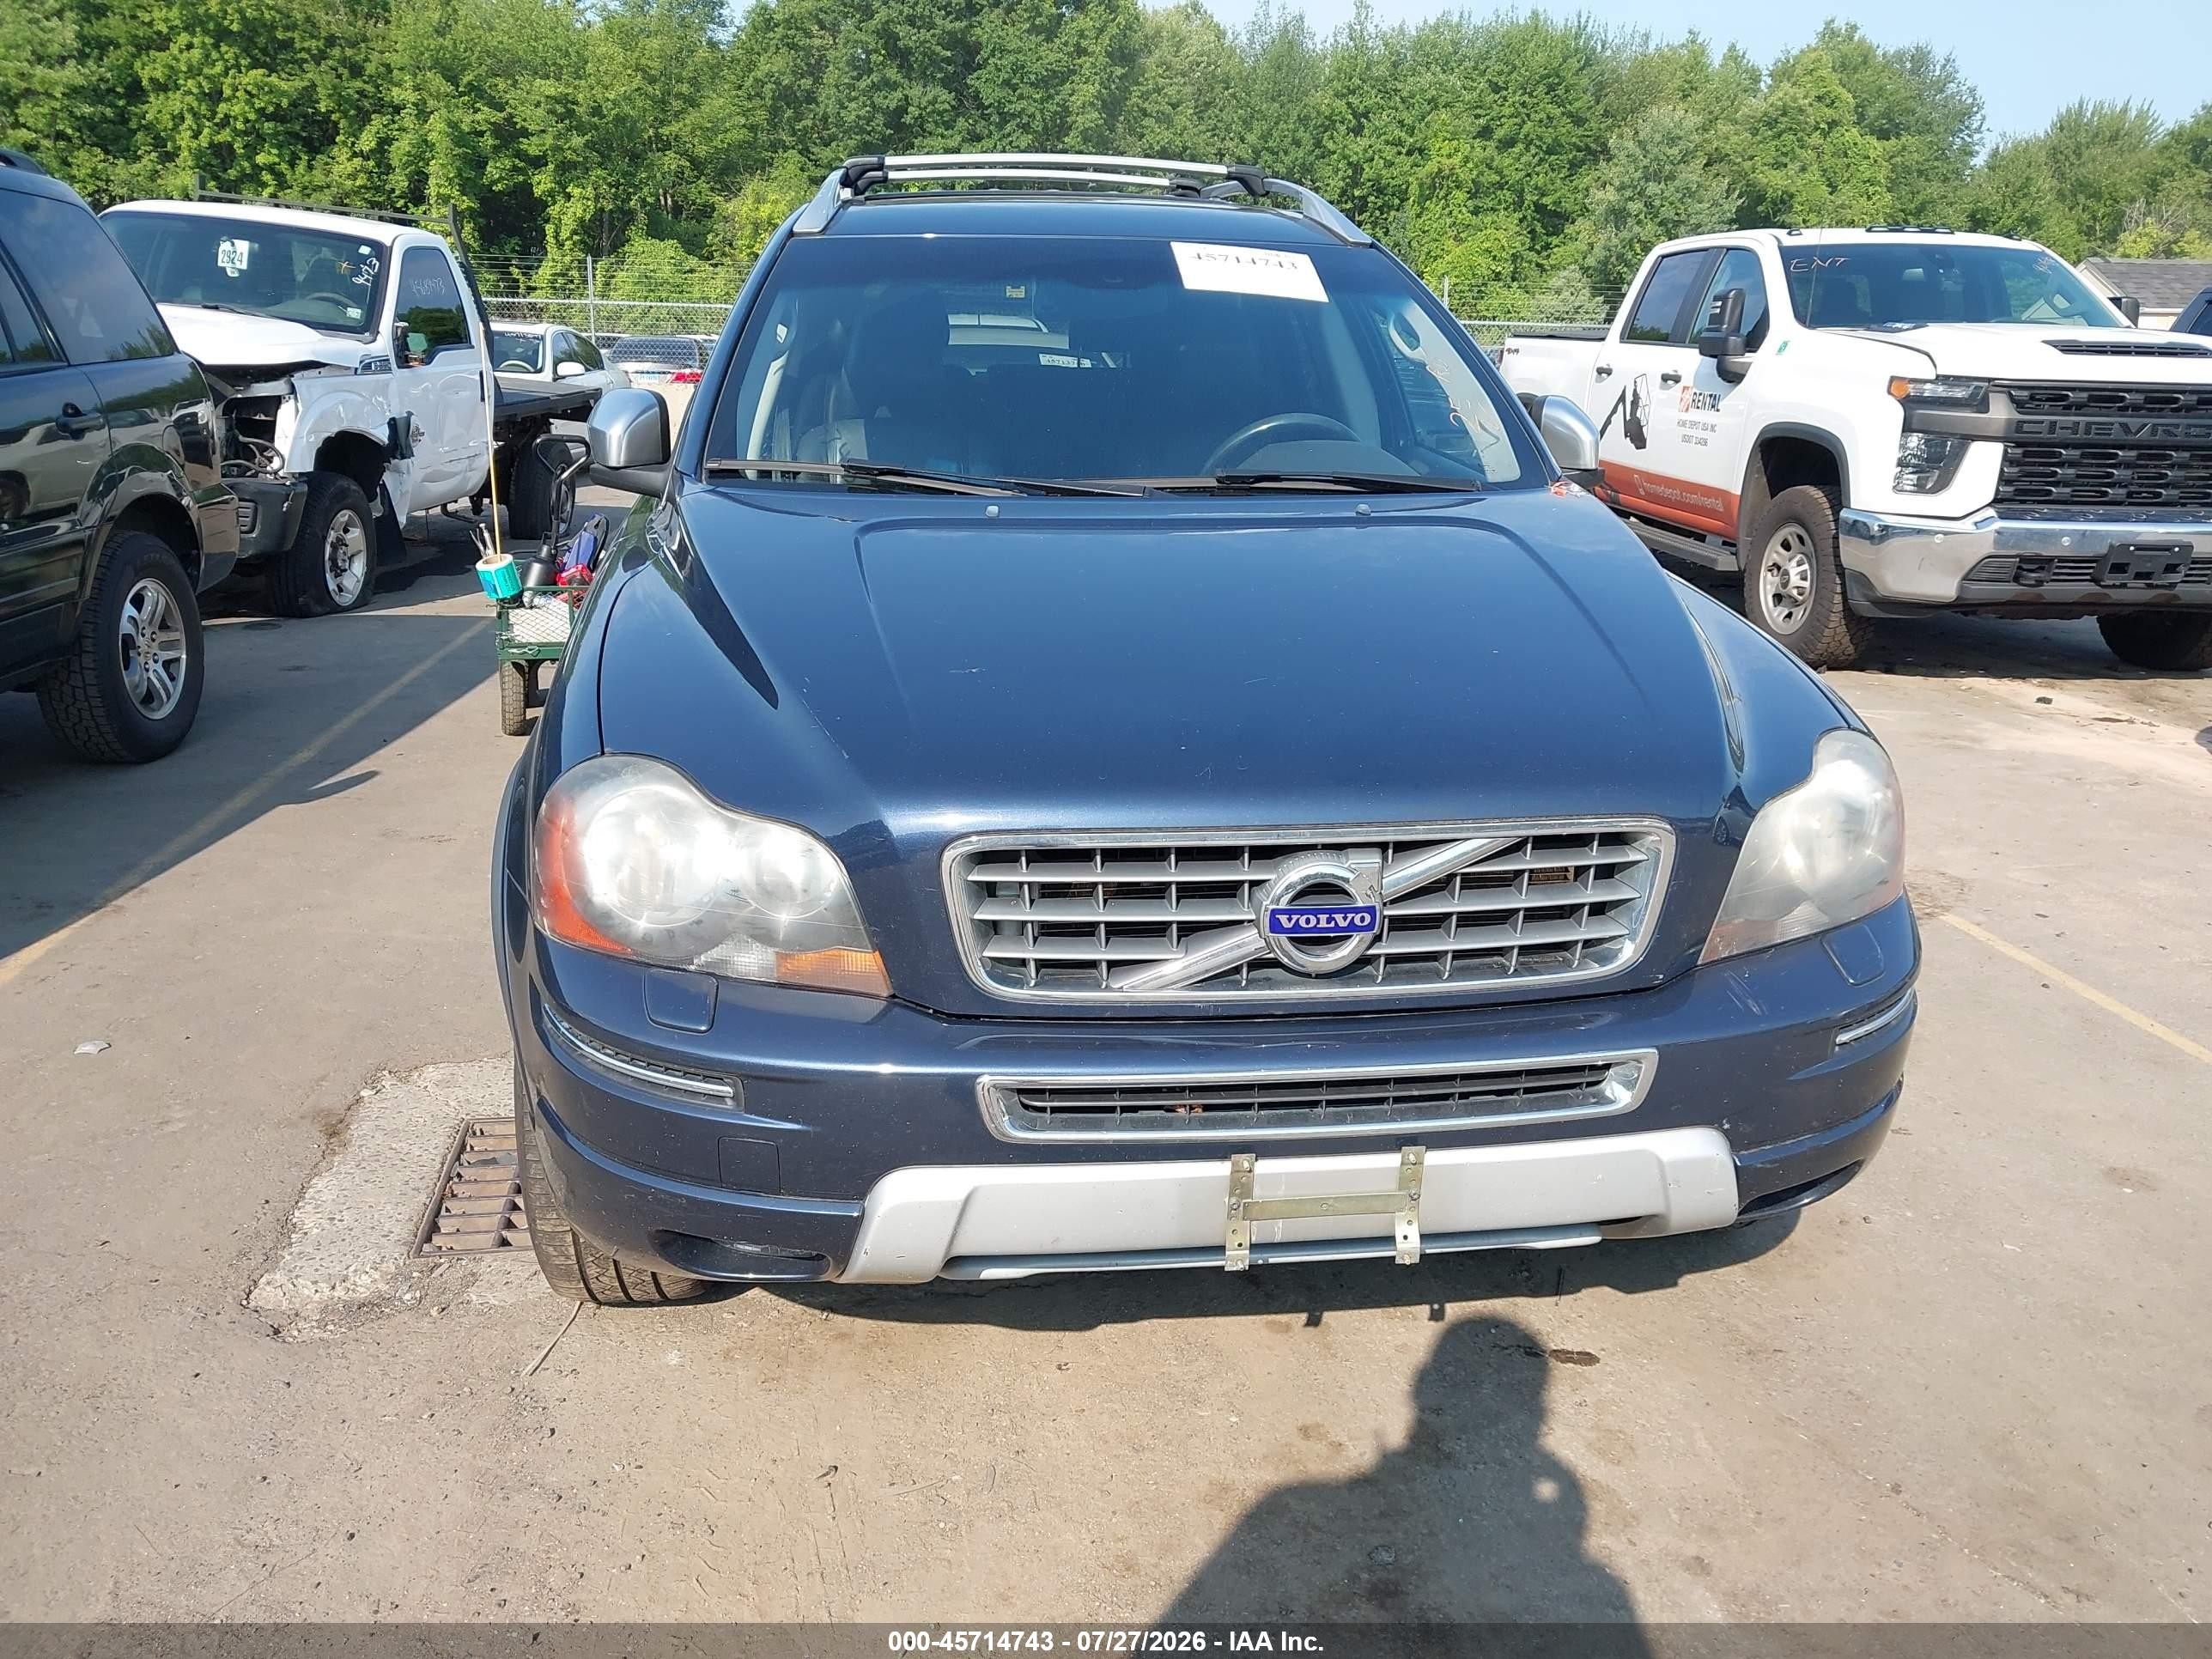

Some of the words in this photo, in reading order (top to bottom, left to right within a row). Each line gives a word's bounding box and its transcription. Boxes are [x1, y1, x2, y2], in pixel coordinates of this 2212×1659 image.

[1790, 256, 1851, 272] ENT
[1691, 392, 1721, 412] RENTAL
[1642, 478, 1724, 512] homedepot.com/rental
[1275, 912, 1371, 928] VOLVO
